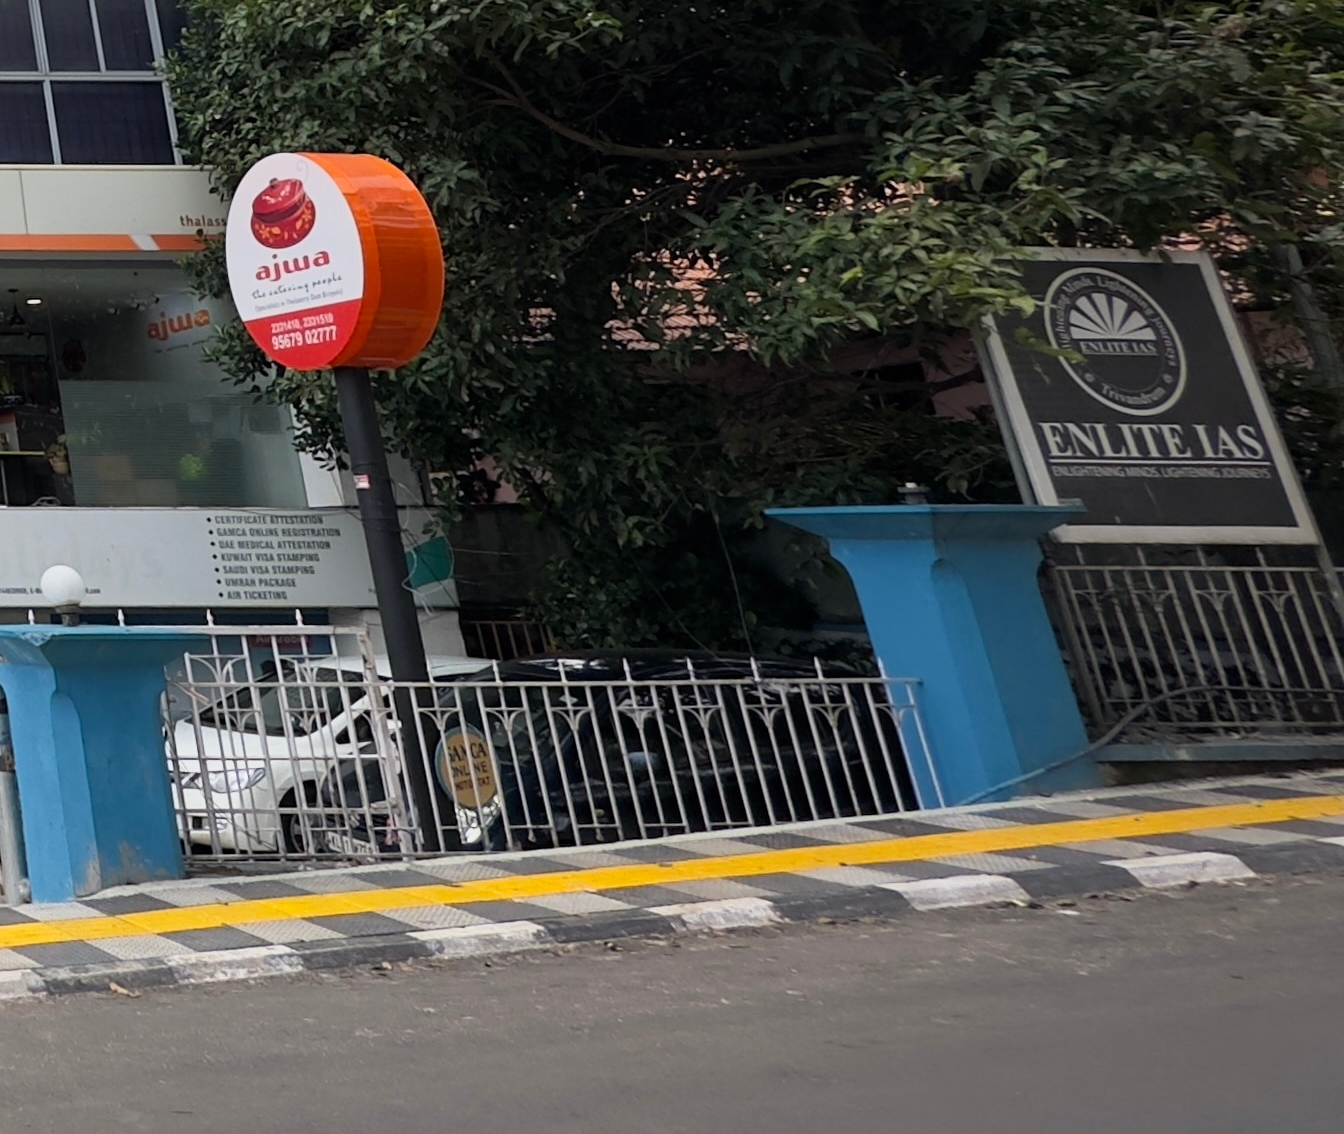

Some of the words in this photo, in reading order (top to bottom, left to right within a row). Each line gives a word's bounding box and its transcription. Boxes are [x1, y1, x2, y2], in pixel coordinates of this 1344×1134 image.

[255, 250, 330, 282] ajwa
[251, 289, 266, 299] the
[312, 272, 342, 288] people
[147, 309, 210, 341] ajwa
[271, 331, 303, 350] 95679
[304, 325, 337, 345] 02777
[1079, 341, 1130, 354] ENLITE
[1133, 342, 1157, 354] IAS
[1100, 382, 1168, 406] Trivandrum
[1038, 422, 1192, 459] ENLITE
[1193, 423, 1266, 460] IAS
[215, 515, 268, 525] CERTIFICATE
[270, 515, 324, 525] ATTESTATION
[216, 527, 247, 537] GAMCA
[249, 527, 279, 537] ONLINE
[281, 527, 341, 537] REGISTRATION
[218, 540, 235, 550] UAE
[237, 540, 275, 550] MEDICAL
[277, 540, 332, 550] ATTESTATION
[220, 553, 253, 562] KUWAIT
[255, 553, 275, 562] VISA
[277, 553, 320, 563] STAMPING
[222, 565, 248, 575] SAUDI
[250, 565, 270, 575] VISA
[272, 565, 316, 575] STAMPING
[258, 578, 297, 588] PACKAGE
[227, 591, 242, 600] AIR
[243, 591, 288, 601] TICKETING
